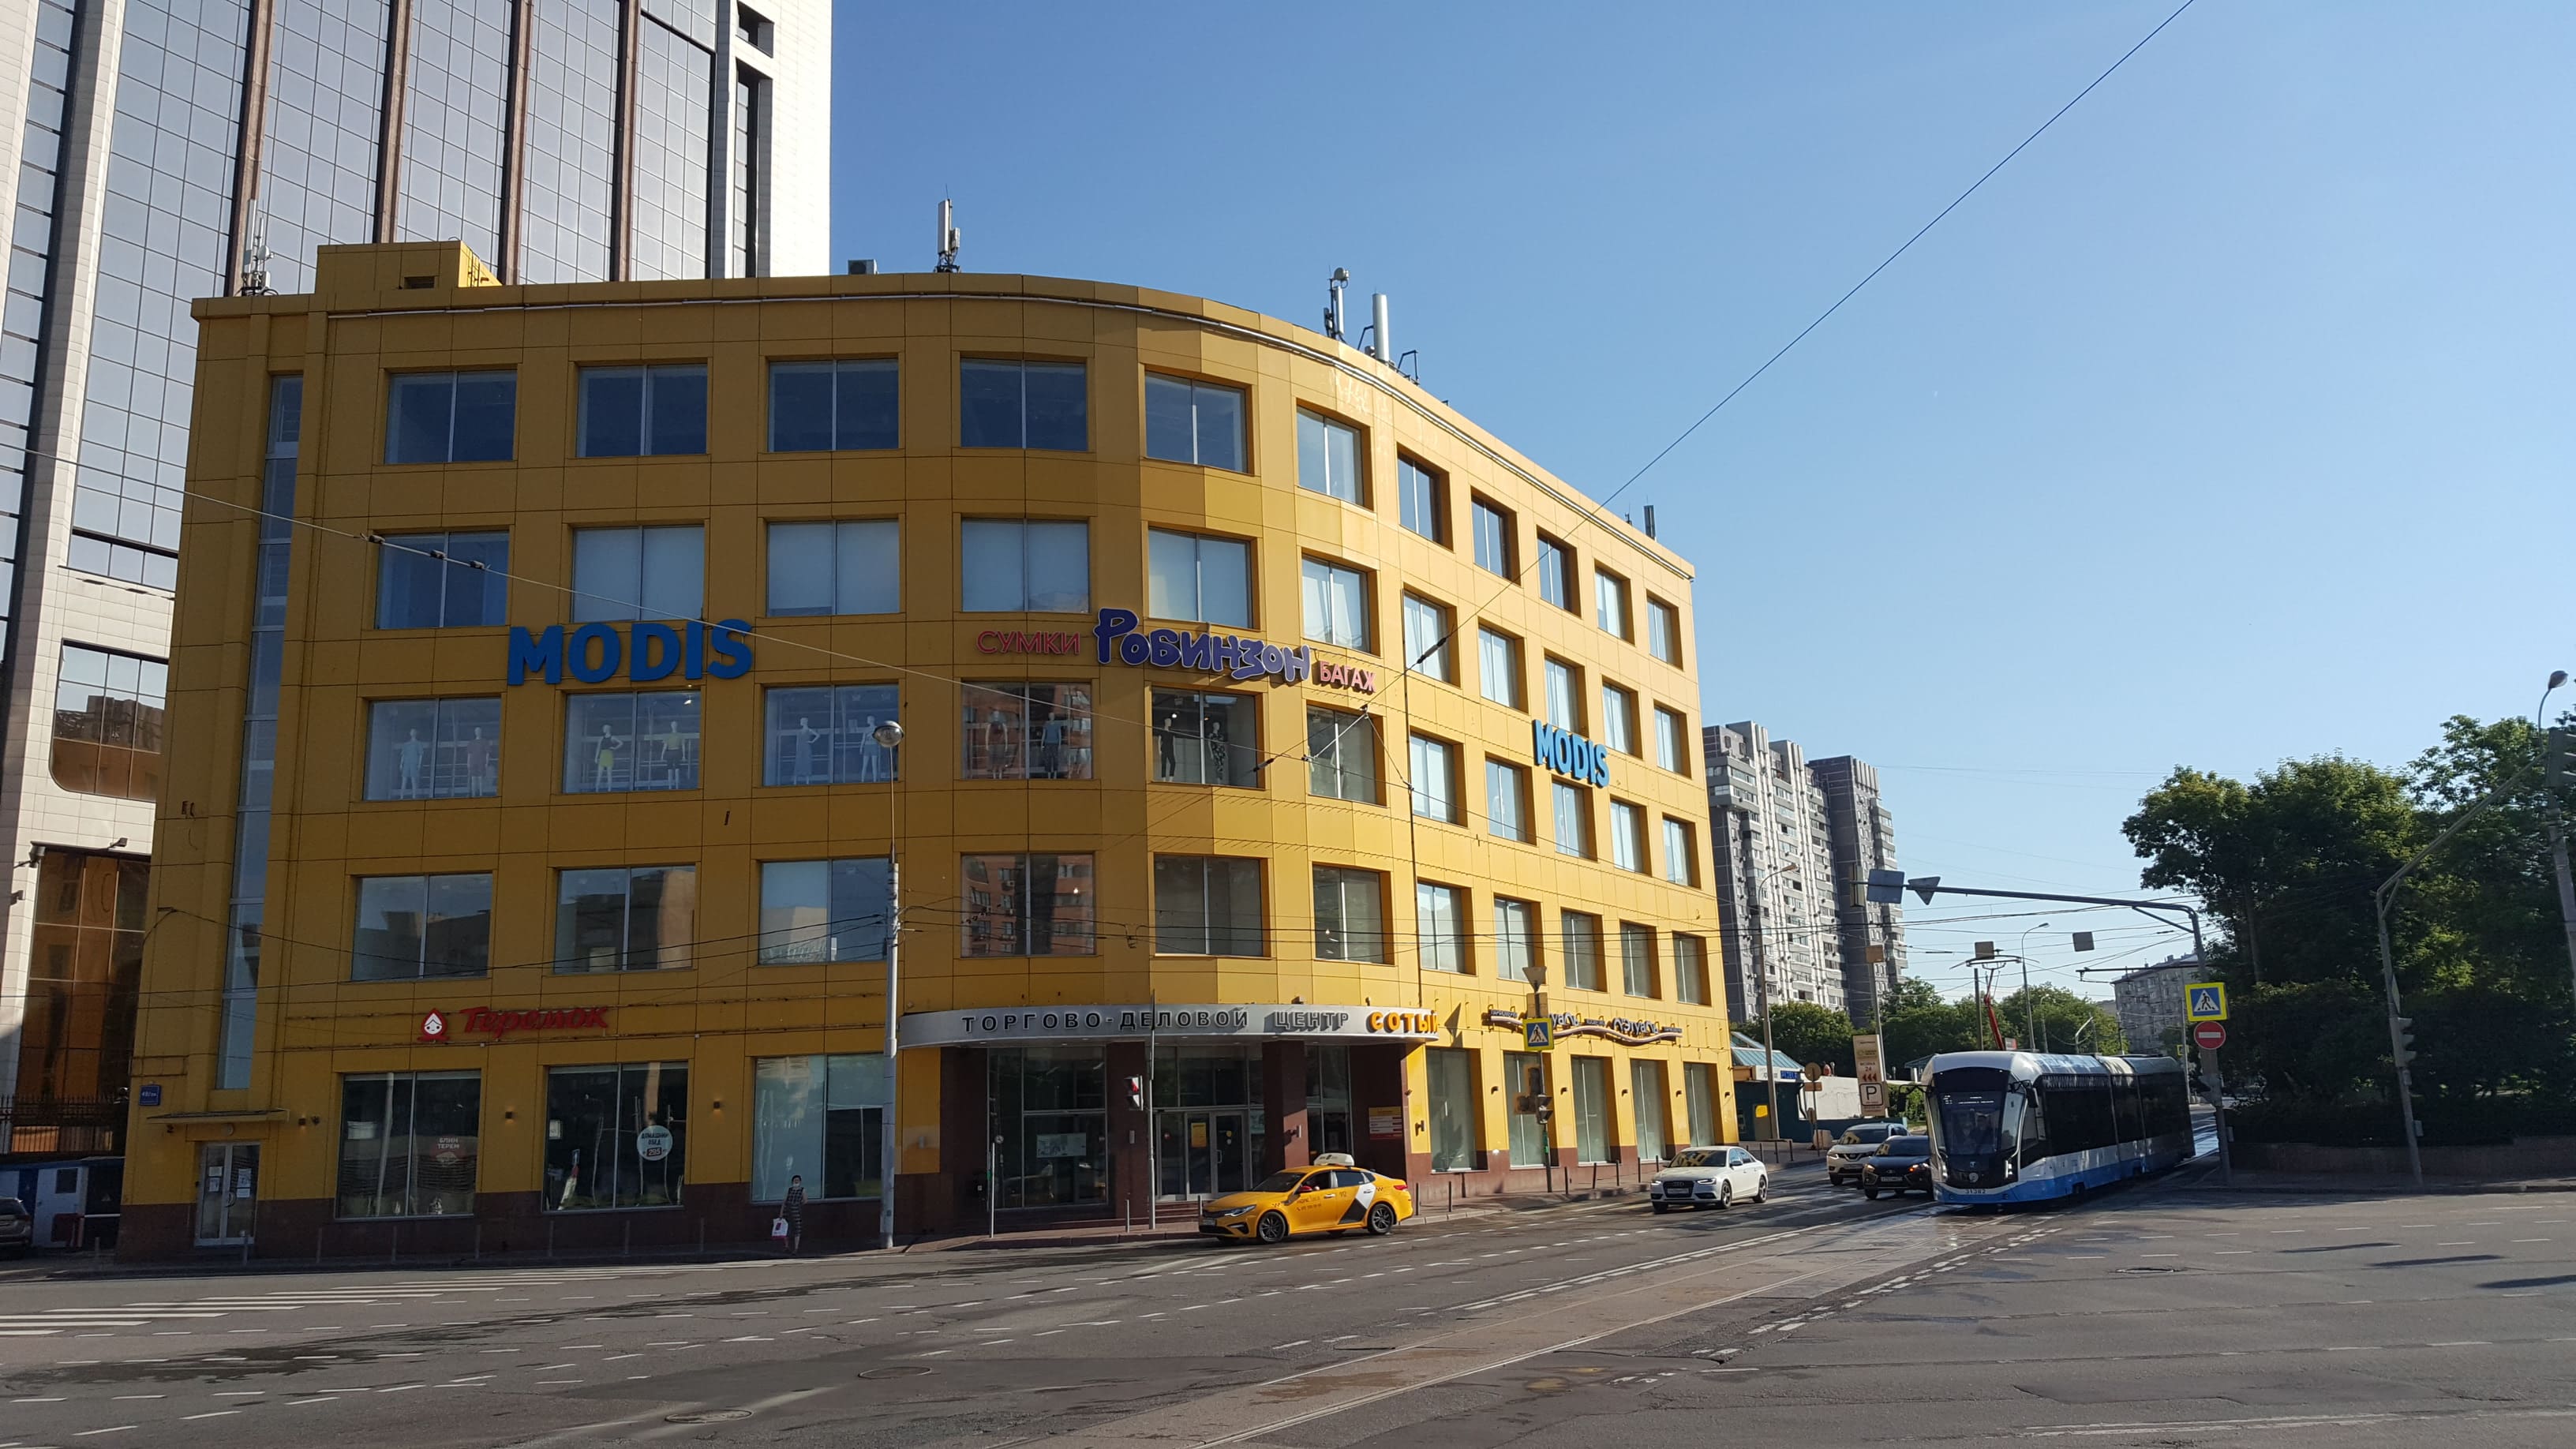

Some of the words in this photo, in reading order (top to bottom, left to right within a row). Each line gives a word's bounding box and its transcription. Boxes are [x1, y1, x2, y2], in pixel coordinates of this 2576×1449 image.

[507, 619, 754, 686] MODIS
[975, 630, 1081, 656] СУМКИ
[1320, 660, 1377, 693] БАГАЖ
[1533, 719, 1610, 788] MODIS
[459, 1006, 608, 1039] Теремок
[1274, 1010, 1350, 1029] ЦЕНТР
[1866, 1086, 1878, 1100] P
